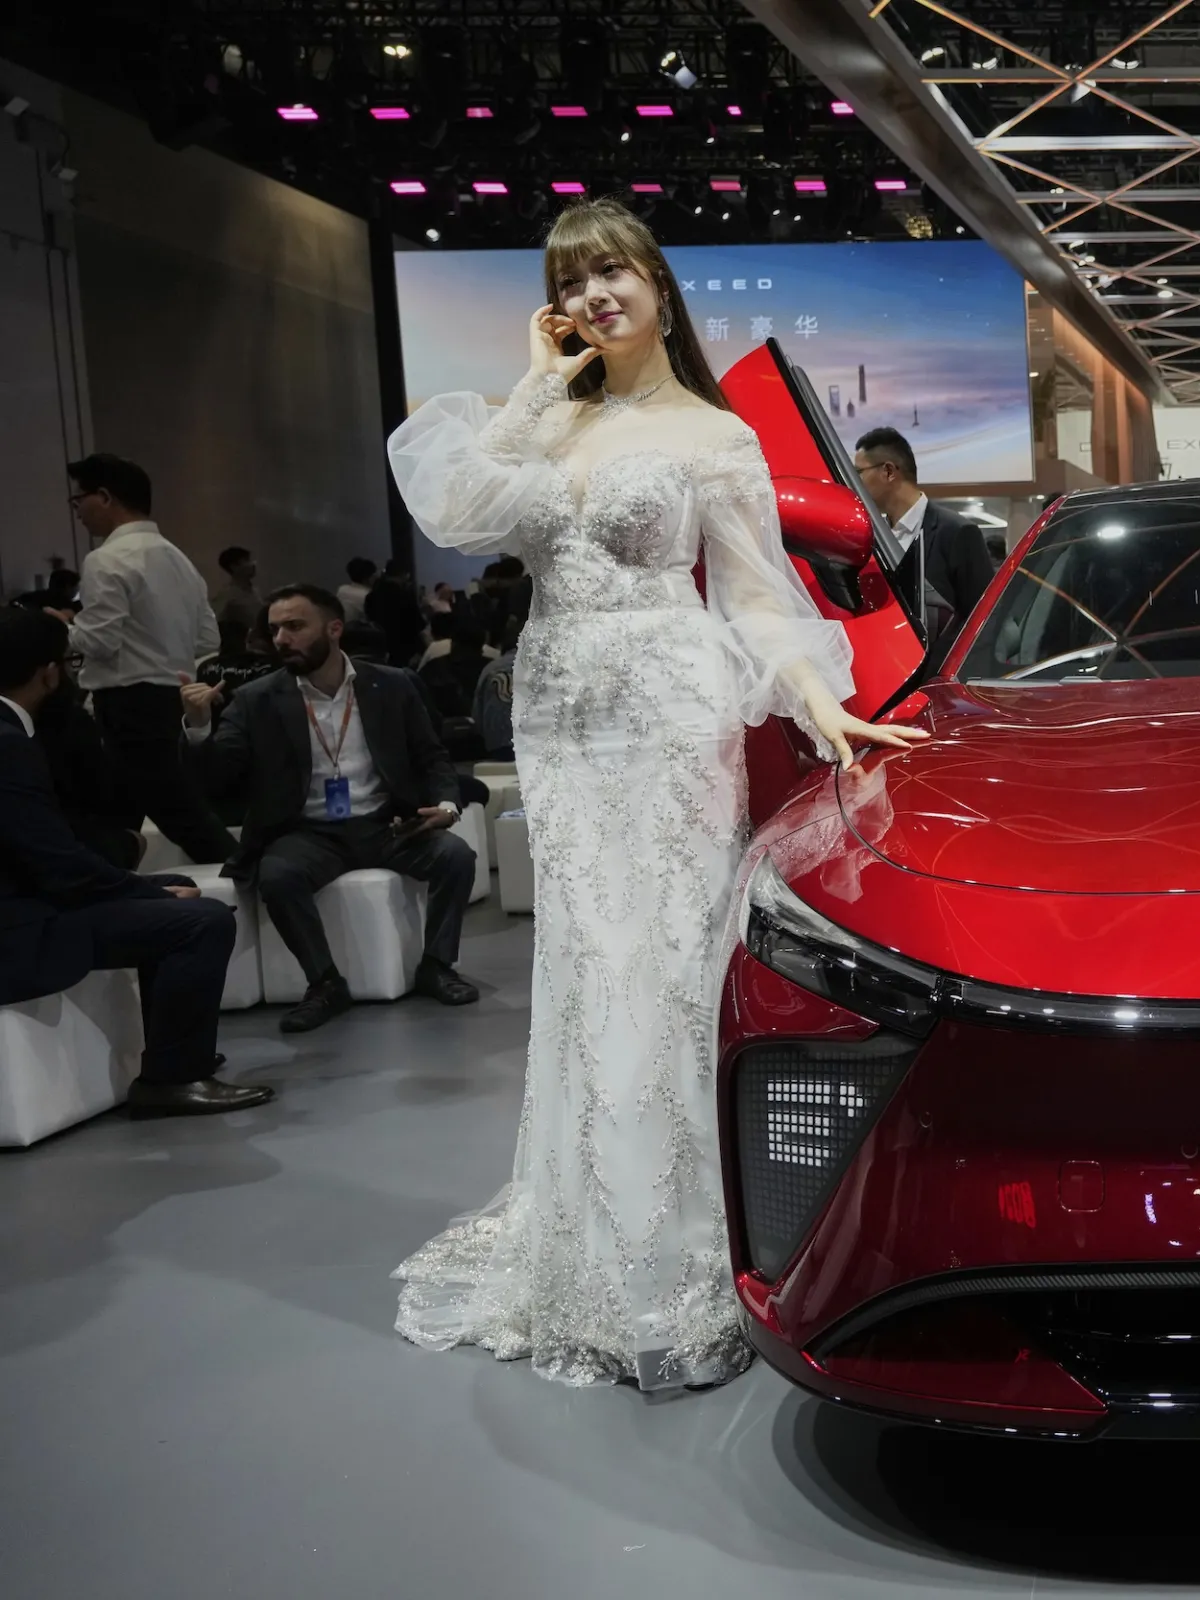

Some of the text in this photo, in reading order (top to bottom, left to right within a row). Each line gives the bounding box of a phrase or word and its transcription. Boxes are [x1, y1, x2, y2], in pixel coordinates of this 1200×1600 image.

[682, 278, 773, 291] XEED
[705, 315, 819, 341] 新豪华
